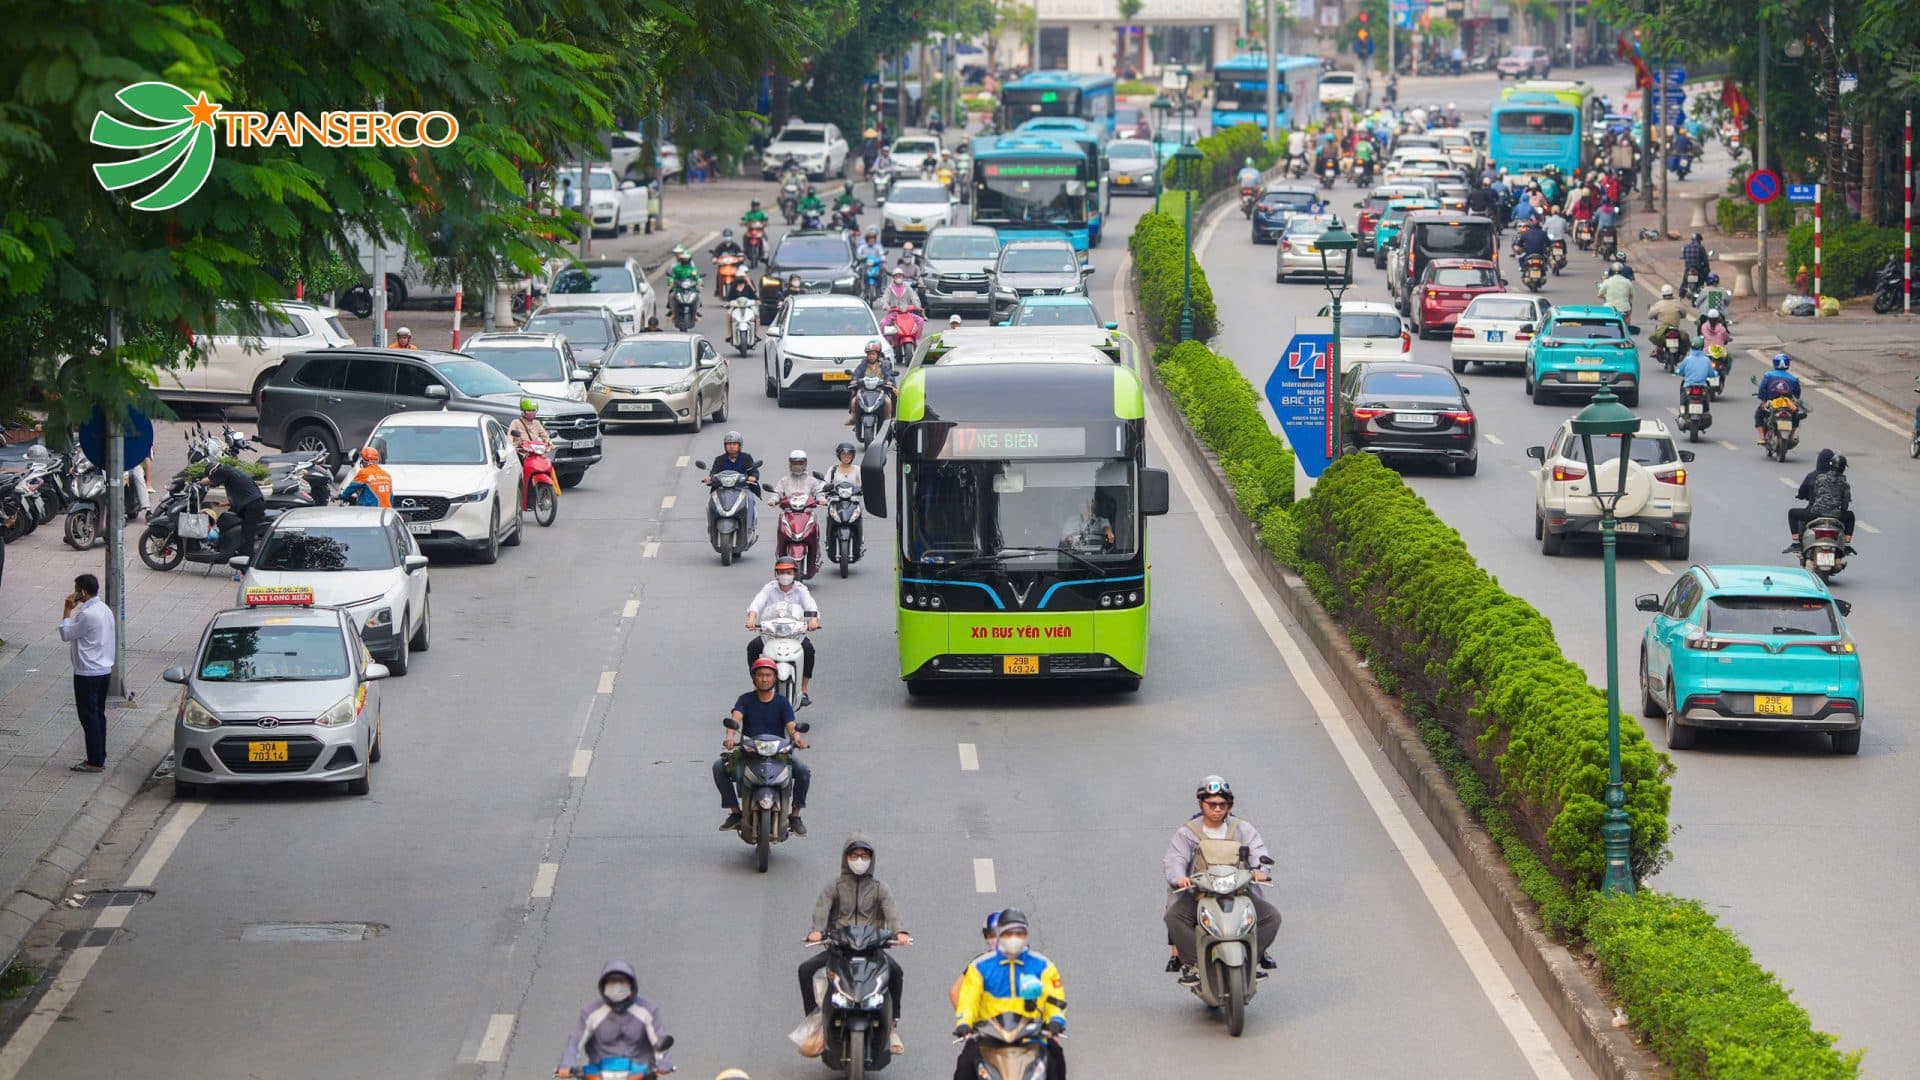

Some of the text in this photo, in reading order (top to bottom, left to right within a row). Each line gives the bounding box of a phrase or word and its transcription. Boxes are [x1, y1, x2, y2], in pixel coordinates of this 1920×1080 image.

[1281, 381, 1325, 389] International
[1297, 388, 1325, 397] Hospital
[1281, 396, 1325, 405] BAC HA
[959, 428, 977, 449] 17
[1004, 430, 1038, 449] BIÊN
[992, 627, 1014, 638] BUS
[1016, 624, 1040, 638] YÊN
[1044, 624, 1072, 638] VIÊN
[260, 743, 276, 751] 30A
